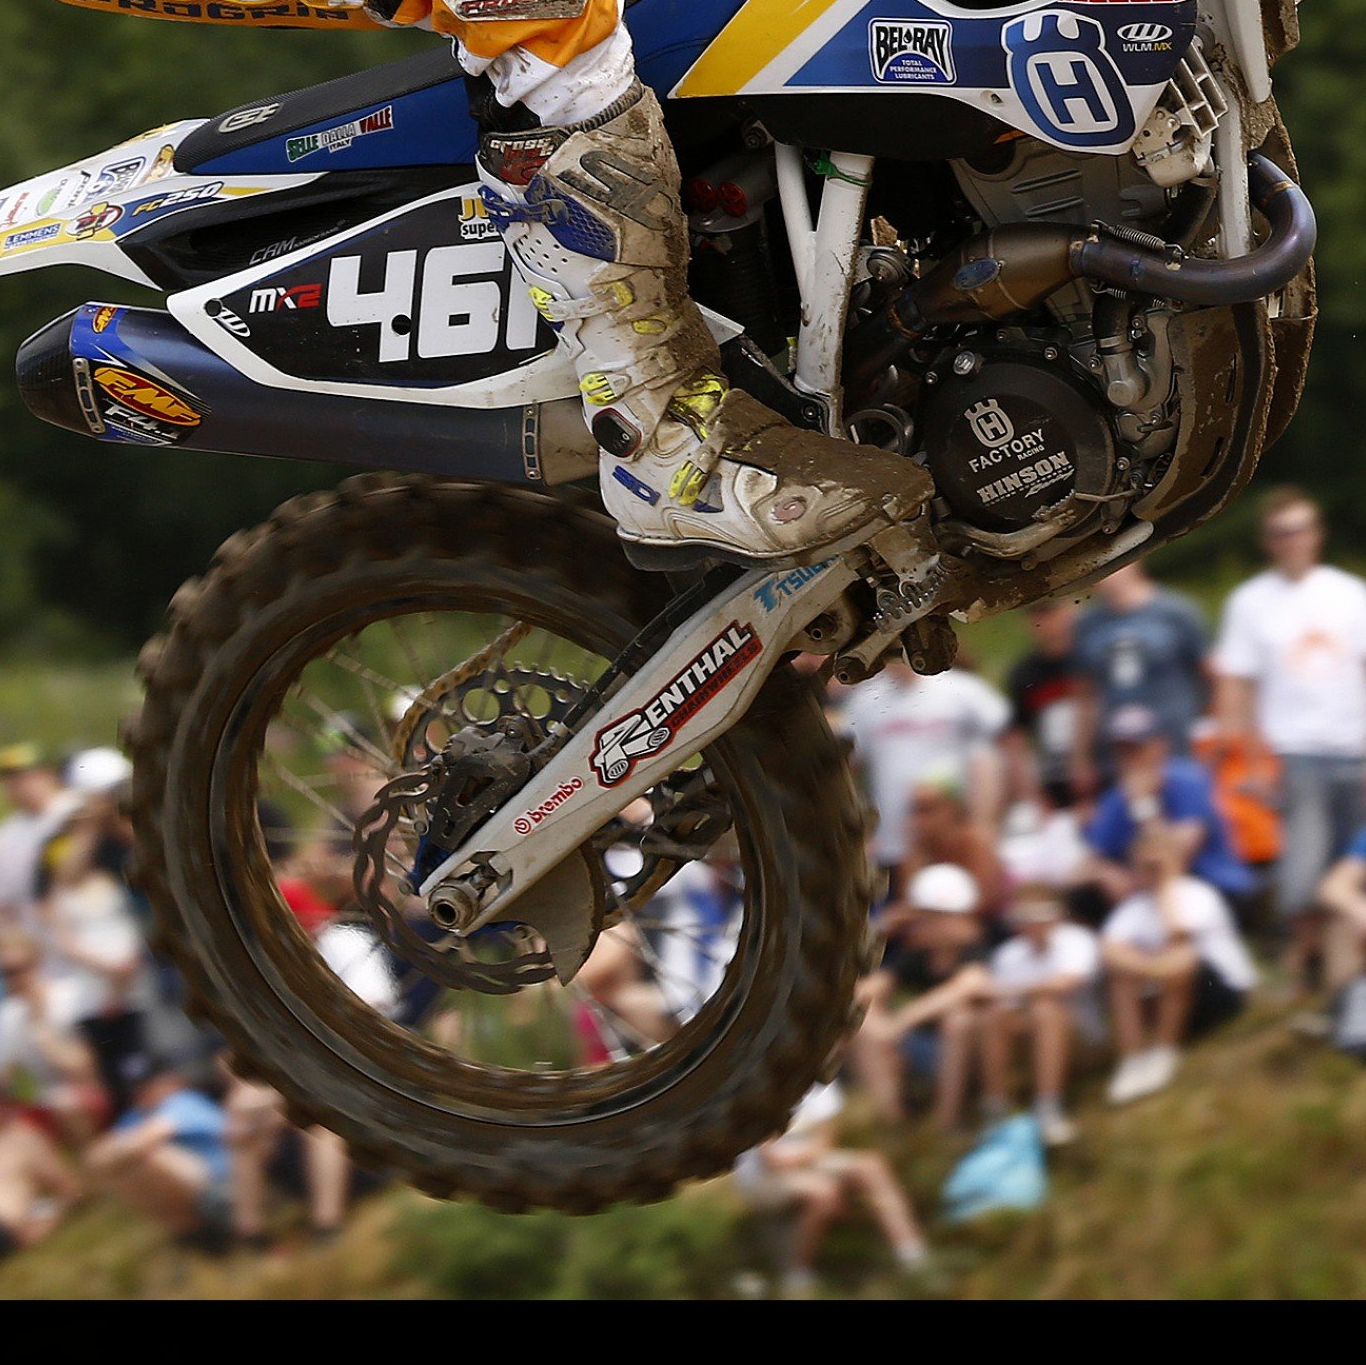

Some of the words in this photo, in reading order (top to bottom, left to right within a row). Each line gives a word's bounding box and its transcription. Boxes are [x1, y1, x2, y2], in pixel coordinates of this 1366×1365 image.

[131, 181, 225, 217] FC250
[248, 283, 323, 314] MX2
[94, 369, 202, 422] FMF
[968, 428, 1045, 473] FACTORY
[1017, 444, 1045, 461] RACING
[976, 450, 1071, 504] HINSON
[527, 778, 583, 824] brembo
